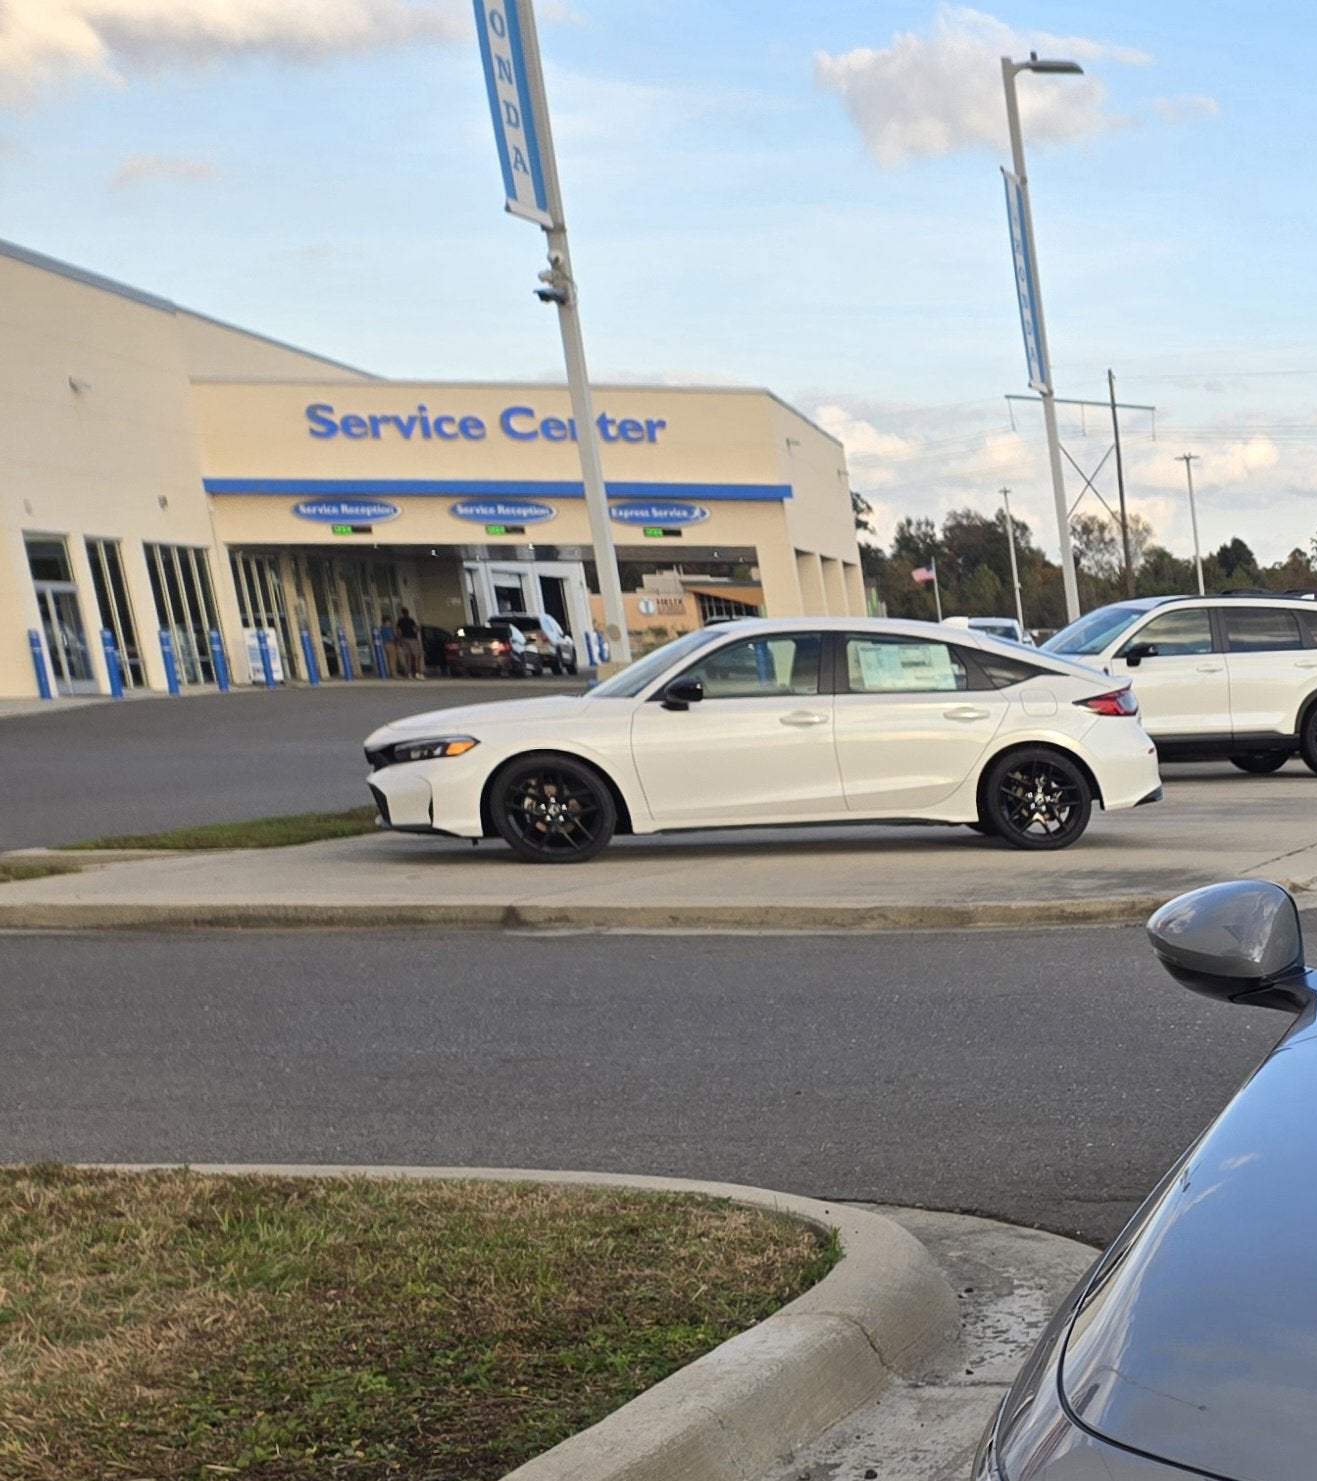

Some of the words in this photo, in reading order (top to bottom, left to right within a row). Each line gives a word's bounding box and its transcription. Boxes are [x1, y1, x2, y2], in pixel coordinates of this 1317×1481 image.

[305, 403, 486, 440] Service
[298, 503, 338, 514] Service
[340, 503, 395, 517] Reception
[457, 504, 495, 515] Service
[497, 504, 550, 517] Reception
[651, 507, 689, 517] Service
